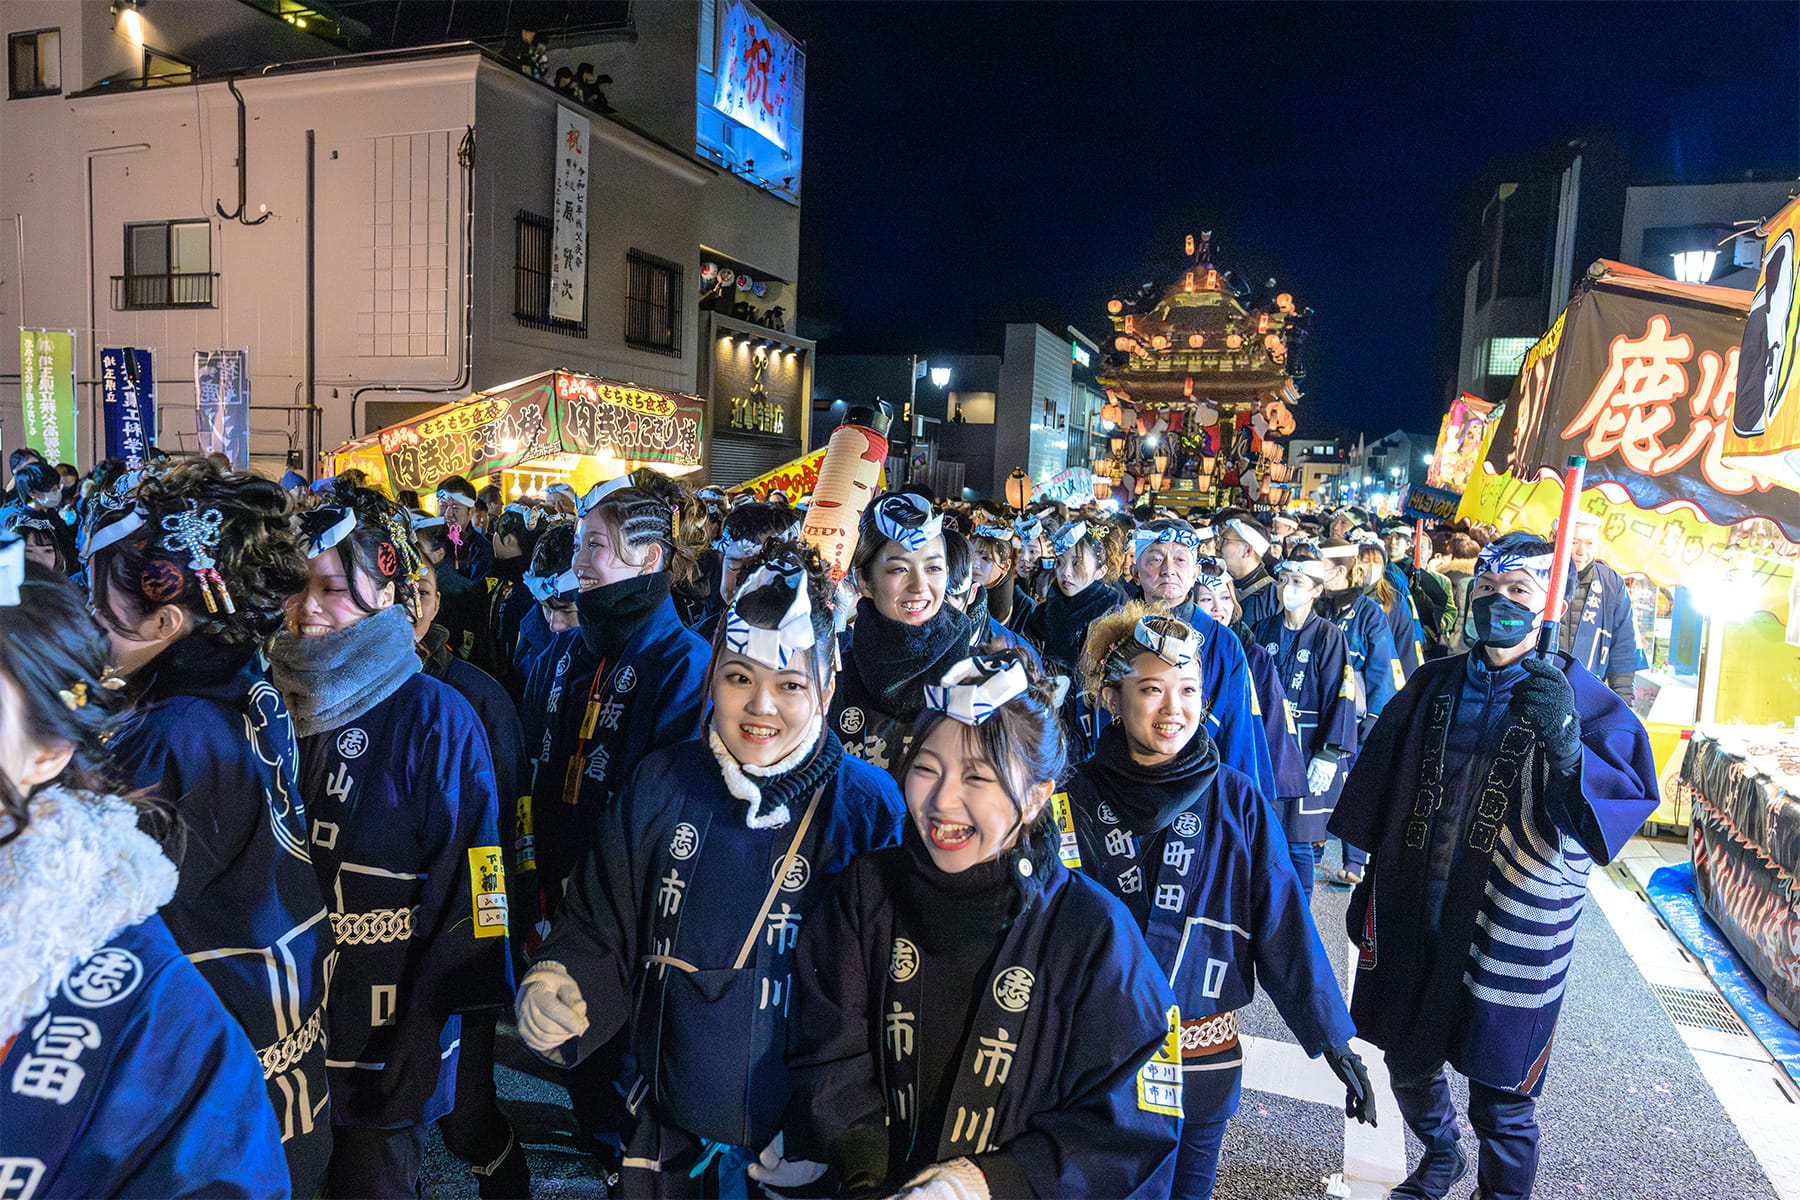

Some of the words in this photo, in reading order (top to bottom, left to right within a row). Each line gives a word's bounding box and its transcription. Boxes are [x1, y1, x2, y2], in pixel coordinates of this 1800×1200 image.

[743, 24, 774, 115] 祝
[566, 129, 582, 155] 祝
[423, 399, 503, 435] もちもち食感
[602, 387, 671, 414] もちもち食感
[583, 695, 625, 782] 板倉
[311, 762, 355, 850] 山口
[1103, 827, 1145, 894] 町田
[1153, 840, 1196, 913] 町田
[759, 903, 802, 1018] 市川
[886, 1001, 915, 1131] 市川
[950, 1028, 1017, 1154] 市川
[1147, 1064, 1176, 1081] 市川
[1149, 1086, 1176, 1104] 市川
